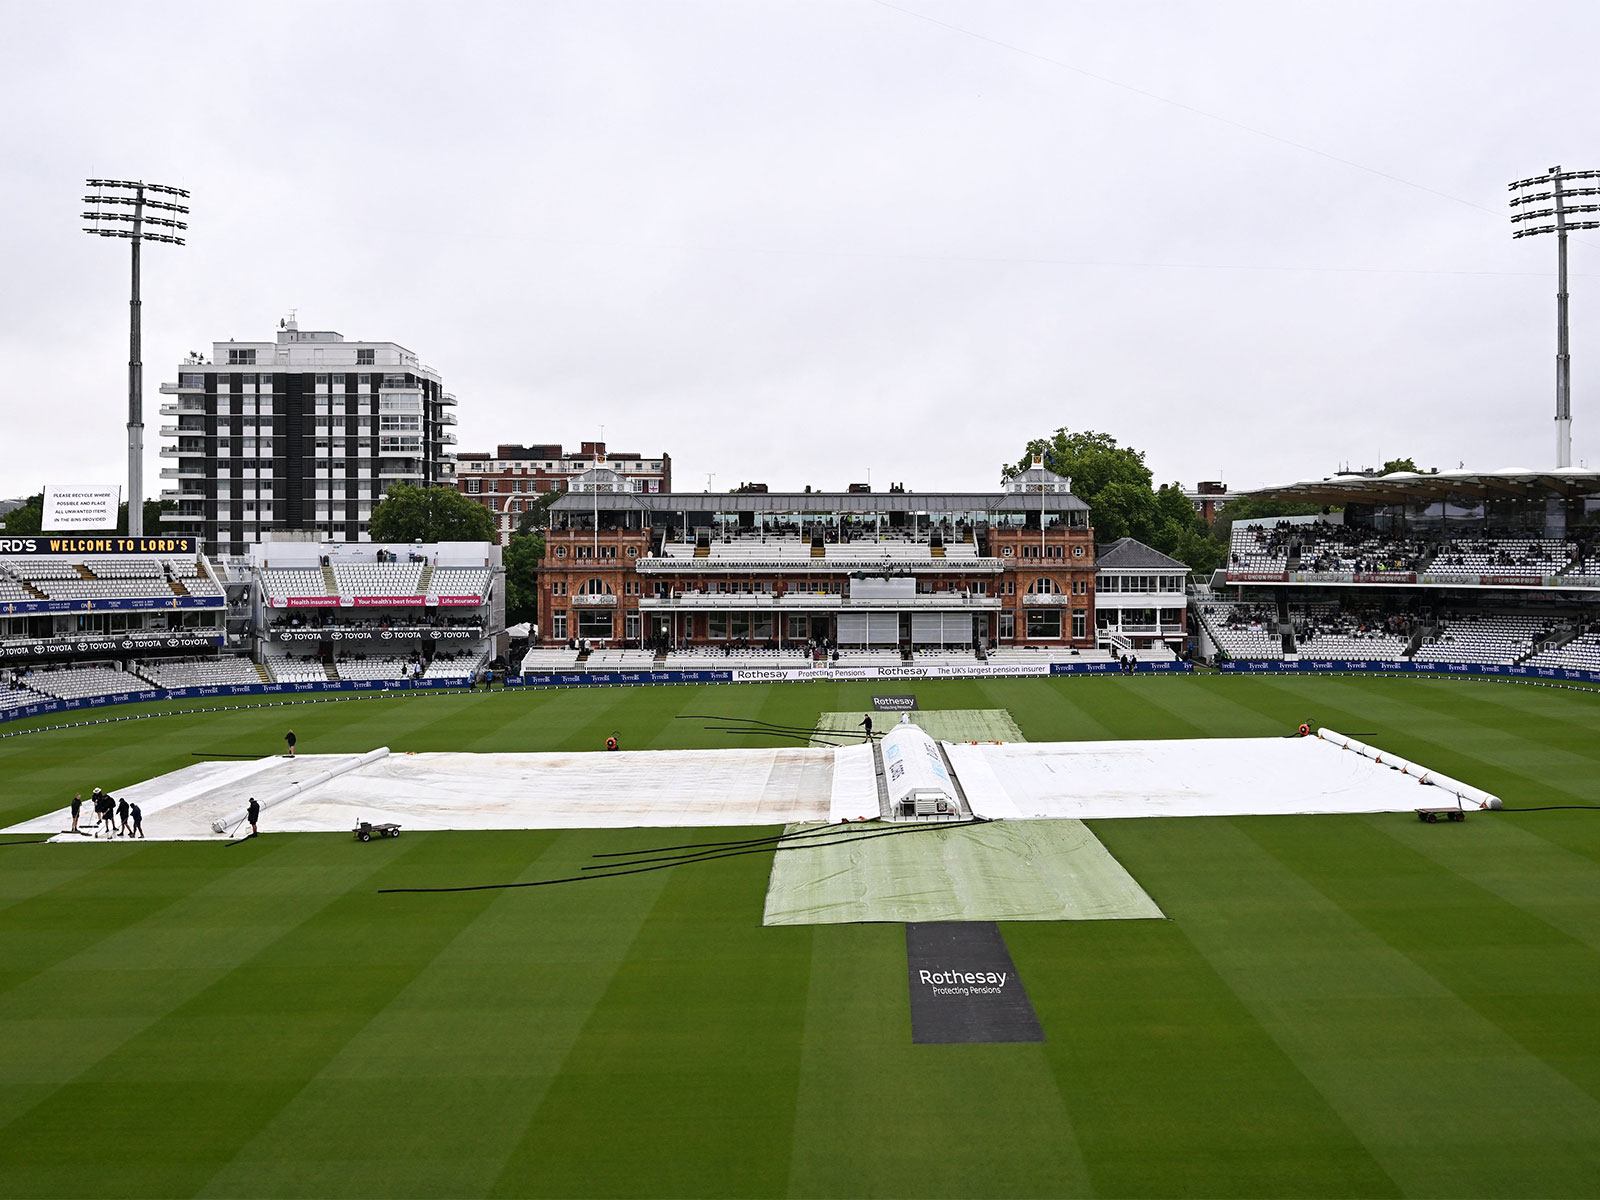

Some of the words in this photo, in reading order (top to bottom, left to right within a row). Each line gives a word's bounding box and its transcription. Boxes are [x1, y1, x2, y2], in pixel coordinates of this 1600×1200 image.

[50, 540, 112, 551] WELCOME
[118, 540, 134, 551] TO
[140, 540, 188, 551] LORD'S
[6, 647, 29, 655] TOYOTA
[738, 670, 788, 679] Rothesay
[798, 669, 833, 678] Protecting
[878, 667, 928, 676] Rothesay
[968, 667, 991, 675] largest
[992, 666, 1020, 674] pension
[874, 697, 914, 706] Rothesay
[920, 970, 1006, 987] Rothesay
[933, 986, 969, 996] Protecting
[970, 986, 1001, 994] Pensions
